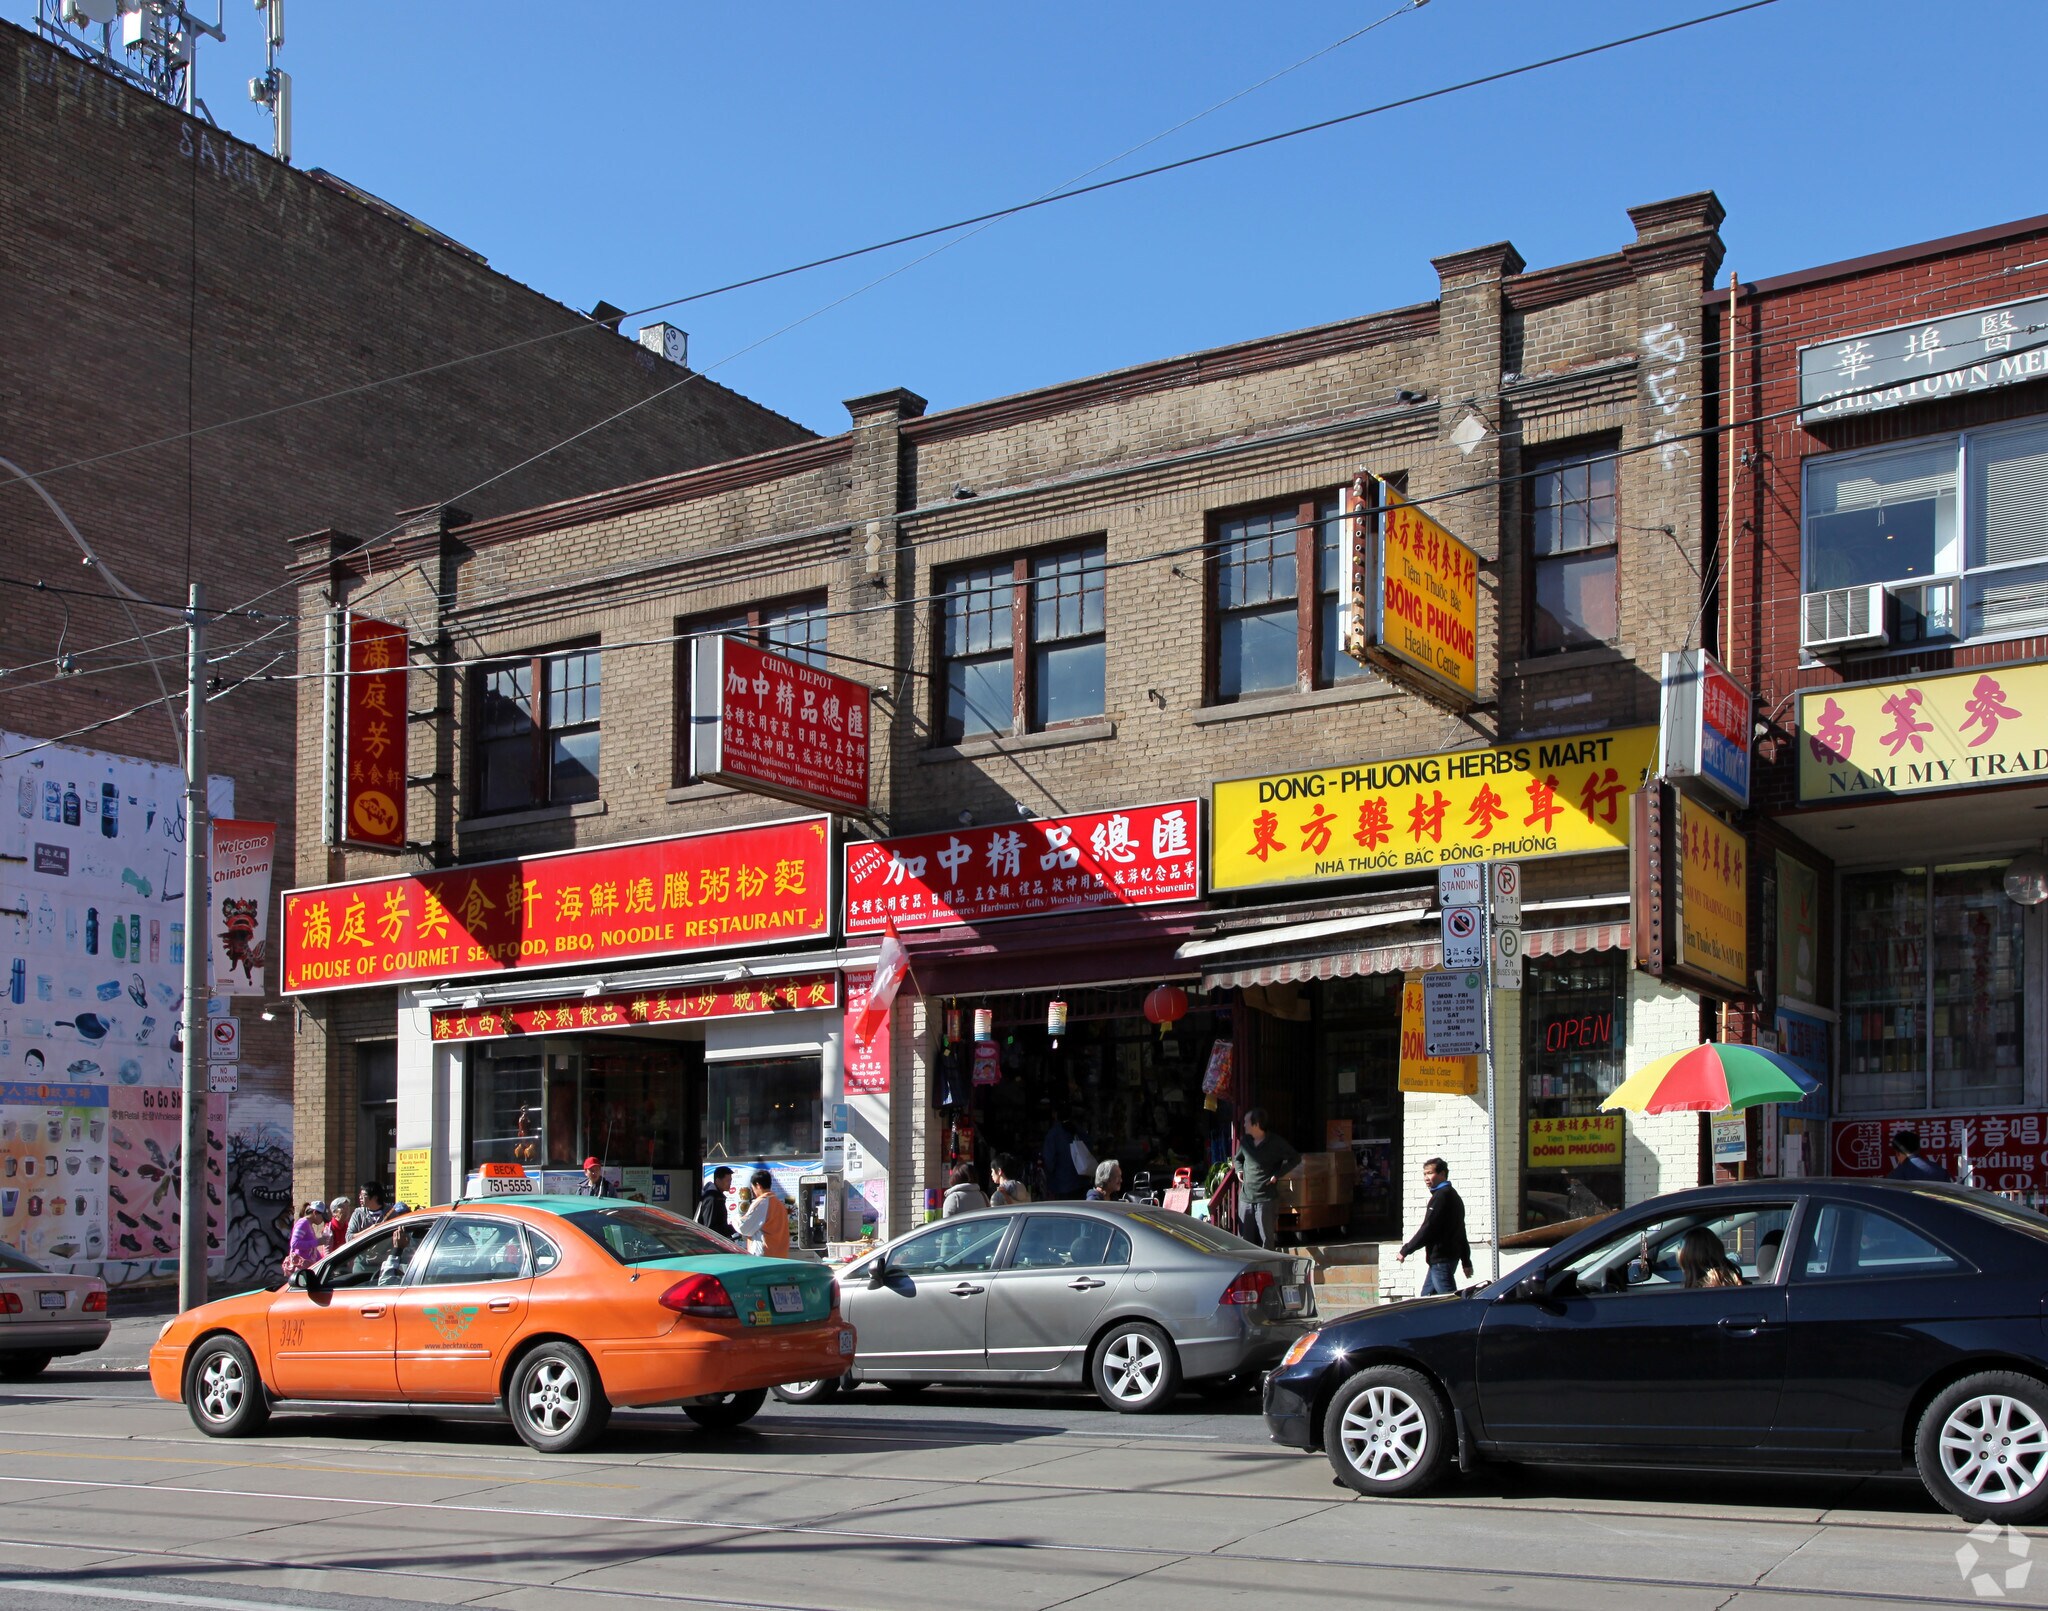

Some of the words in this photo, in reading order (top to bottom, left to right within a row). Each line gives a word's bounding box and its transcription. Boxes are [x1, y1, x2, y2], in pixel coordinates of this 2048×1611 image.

[1817, 362, 1989, 414] CHINATOWN
[1385, 575, 1423, 629] ĐÔNG
[1404, 626, 1432, 664] Health
[1436, 646, 1461, 680] Center
[761, 655, 795, 678] CHINA
[799, 668, 833, 690] DEPOT
[360, 633, 393, 760] 滿庭芳
[725, 665, 865, 739] 加中精品總匯
[724, 743, 757, 761] Household
[757, 750, 791, 771] Appliances
[795, 763, 830, 782] Housewares
[832, 772, 863, 789] Hardwares
[1447, 749, 1531, 781] HERBS
[1538, 738, 1614, 769] MART
[730, 759, 747, 773] Gifts
[751, 763, 777, 781] Worship
[777, 771, 803, 787] Supplies
[830, 786, 858, 801] Souvenirs
[1828, 765, 1897, 794] NAM
[1907, 759, 1955, 785] MY
[217, 835, 269, 855] Welcome
[234, 854, 248, 866] To
[850, 846, 880, 874] CHINA
[881, 808, 1193, 887] 加中精品總匯
[213, 862, 269, 883] Chinatown
[854, 853, 887, 885] DEPOT
[1453, 867, 1466, 878] NO
[1441, 879, 1479, 892] STANDING
[301, 873, 542, 951] 滿庭芳美食軒
[850, 914, 887, 928] Household
[889, 910, 927, 925] ppliances
[932, 906, 975, 918] Housewares
[980, 901, 1020, 913] Hardwares
[1026, 899, 1045, 909] Gifts
[1050, 894, 1082, 908] Worship
[1083, 890, 1117, 904] Supplies
[1155, 880, 1195, 895] Souvenirs
[301, 961, 351, 982] HOUSE
[355, 957, 378, 976] OF
[382, 946, 460, 971] GOURMET
[467, 935, 549, 962] SEAFOOD,
[554, 933, 596, 953] BBQ,
[600, 923, 674, 946] NOODLE
[684, 907, 809, 938] RESTAURANT
[1446, 948, 1452, 956] 3
[1466, 947, 1472, 955] 6
[847, 972, 873, 983] Wholesale
[1504, 959, 1509, 967] 2
[1509, 959, 1514, 967] h
[434, 1012, 520, 1040] 港式西餐
[631, 991, 717, 1022] 精美小炒
[1546, 1013, 1612, 1052] OPEN
[211, 1076, 237, 1084] STANDING
[143, 1090, 155, 1108] Go
[157, 1090, 169, 1108] Go
[1716, 1135, 1741, 1143] MILLION
[493, 1164, 516, 1176] BECK
[1954, 1150, 2036, 1171] rading
[487, 1179, 533, 1193] 751-5555
[424, 1341, 484, 1350] www.becktaxi.com
